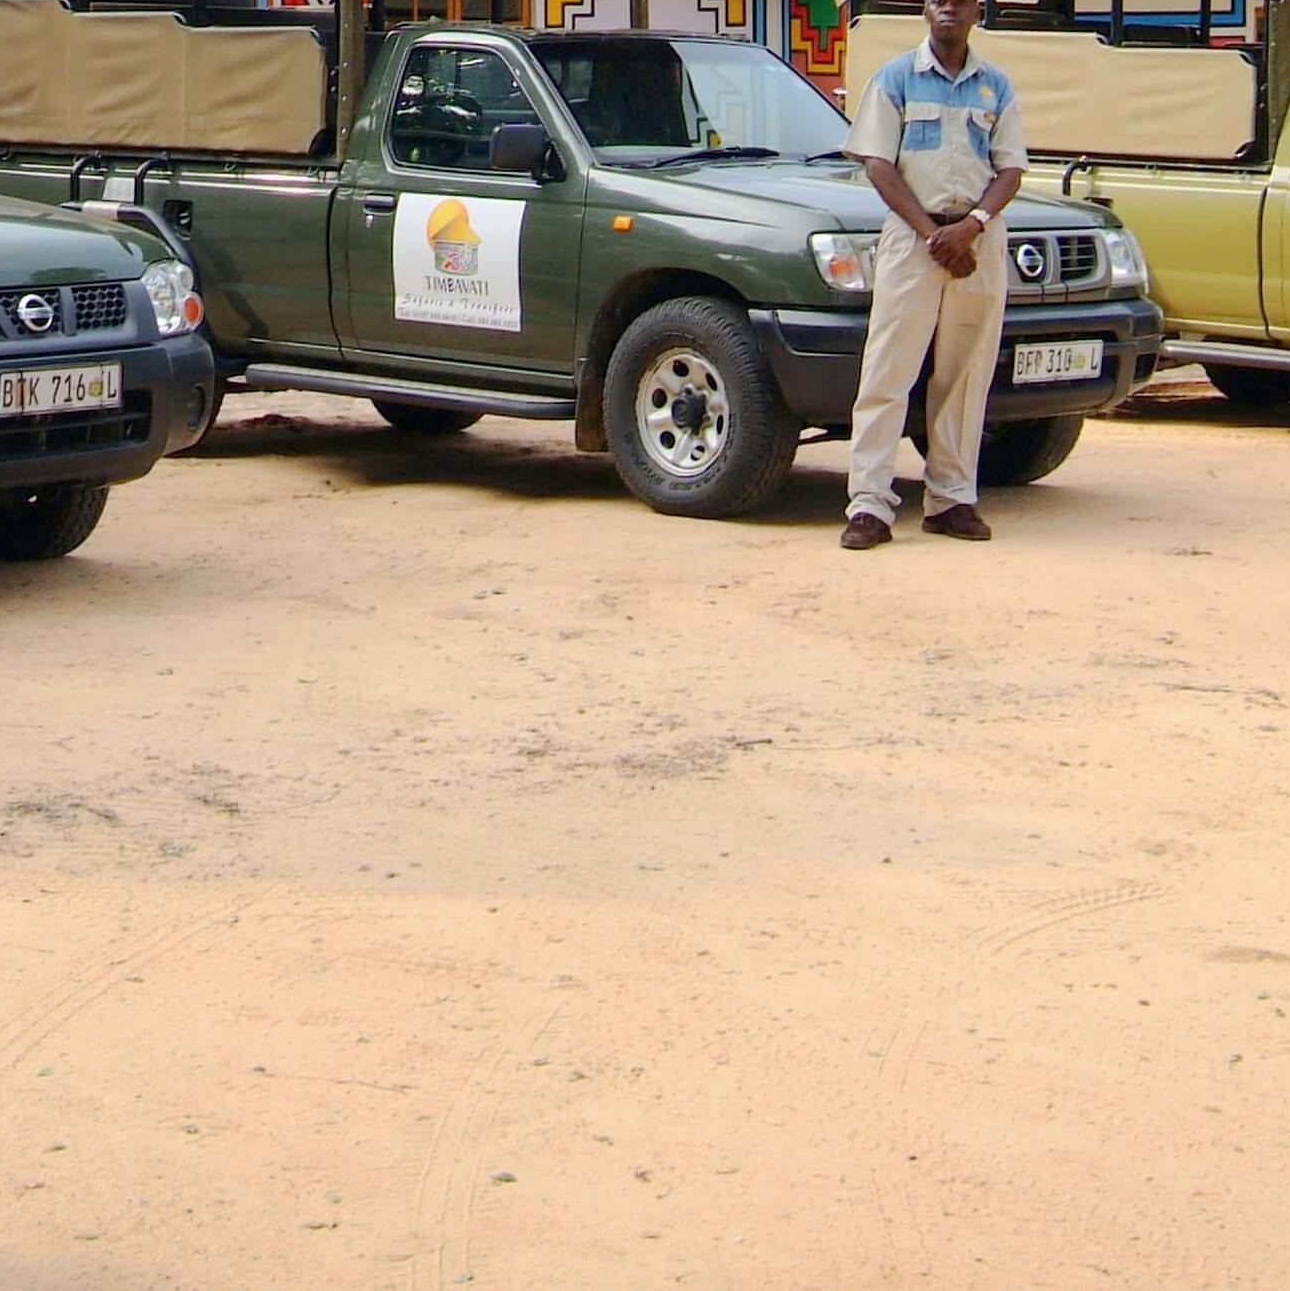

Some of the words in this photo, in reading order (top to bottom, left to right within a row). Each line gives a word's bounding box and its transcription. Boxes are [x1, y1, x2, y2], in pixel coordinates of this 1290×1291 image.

[424, 276, 489, 296] TIMBAVATI
[1090, 345, 1099, 371] L
[52, 373, 86, 404] 716
[107, 370, 117, 398] L
